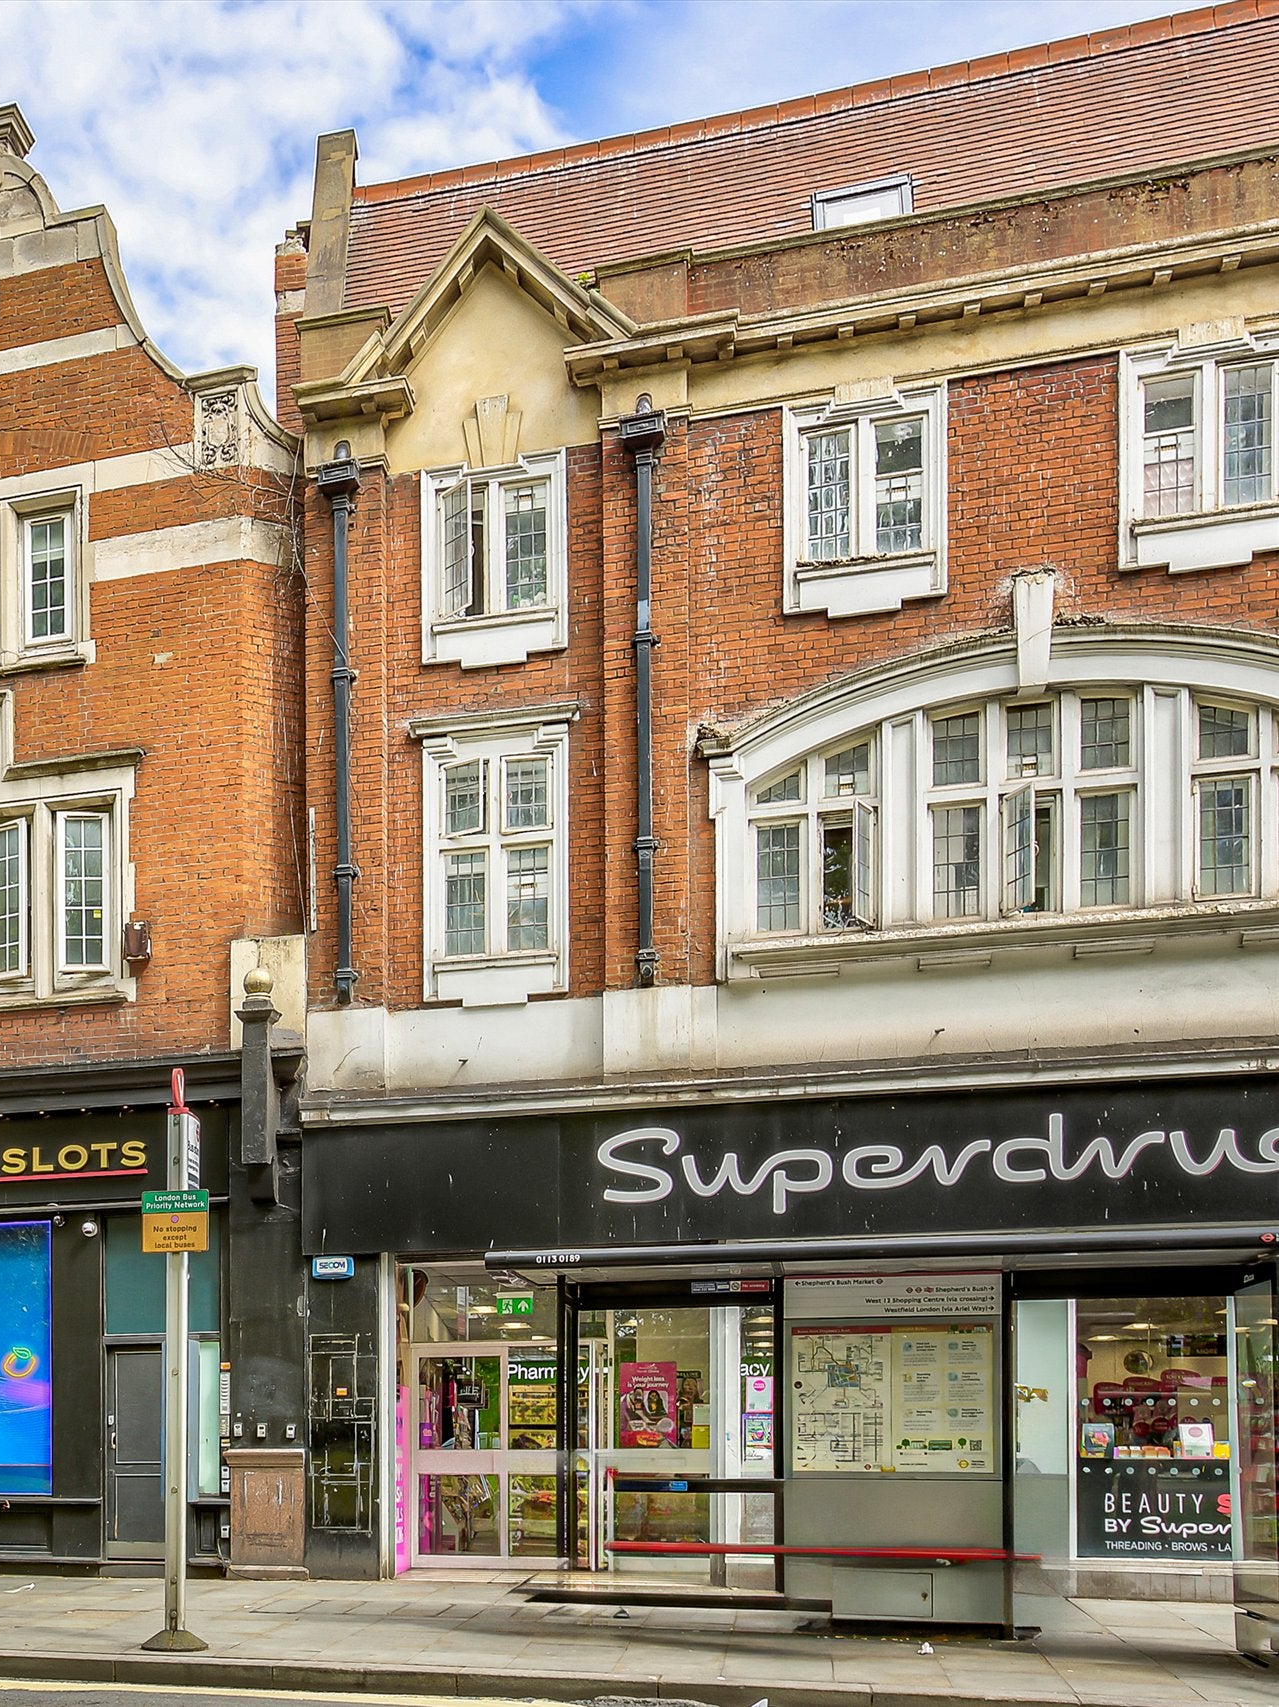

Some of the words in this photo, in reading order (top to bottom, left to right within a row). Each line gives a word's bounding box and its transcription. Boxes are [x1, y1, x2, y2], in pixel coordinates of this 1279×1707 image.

[1, 1140, 148, 1174] SLOTS
[146, 1202, 173, 1210] Priority
[166, 1225, 197, 1233] stopping
[508, 1364, 590, 1385] Pharmy
[1104, 1492, 1204, 1514] BEAUTY
[1104, 1518, 1132, 1533] BY
[1140, 1515, 1232, 1539] Super
[1104, 1540, 1162, 1551] THREADING
[1171, 1542, 1208, 1552] BROWS
[1218, 1543, 1232, 1552] LA
